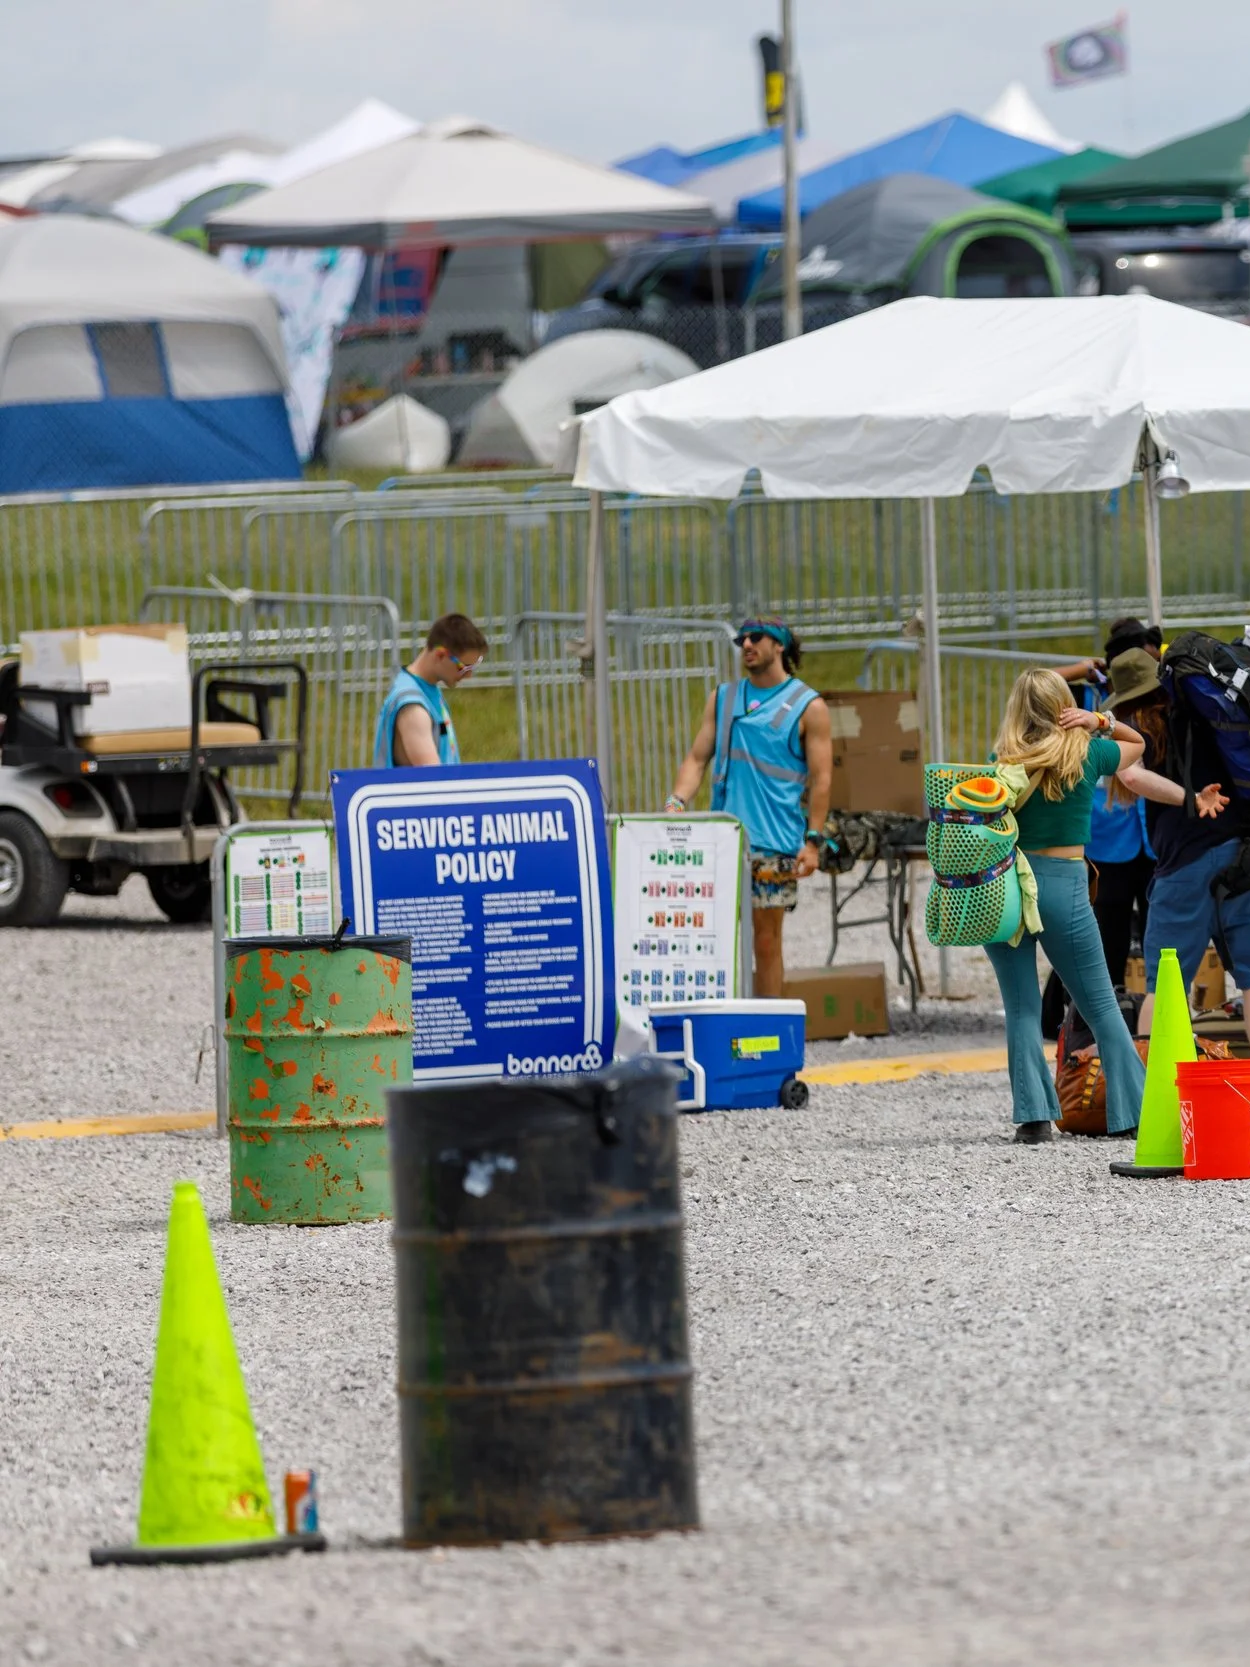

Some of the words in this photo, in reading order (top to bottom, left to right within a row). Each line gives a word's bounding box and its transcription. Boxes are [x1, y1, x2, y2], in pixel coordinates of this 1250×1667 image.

[376, 815, 476, 851] SERVICE
[480, 810, 569, 846] ANIMAL
[435, 849, 516, 884] POLICY
[564, 1070, 600, 1078] FESTIVAL
